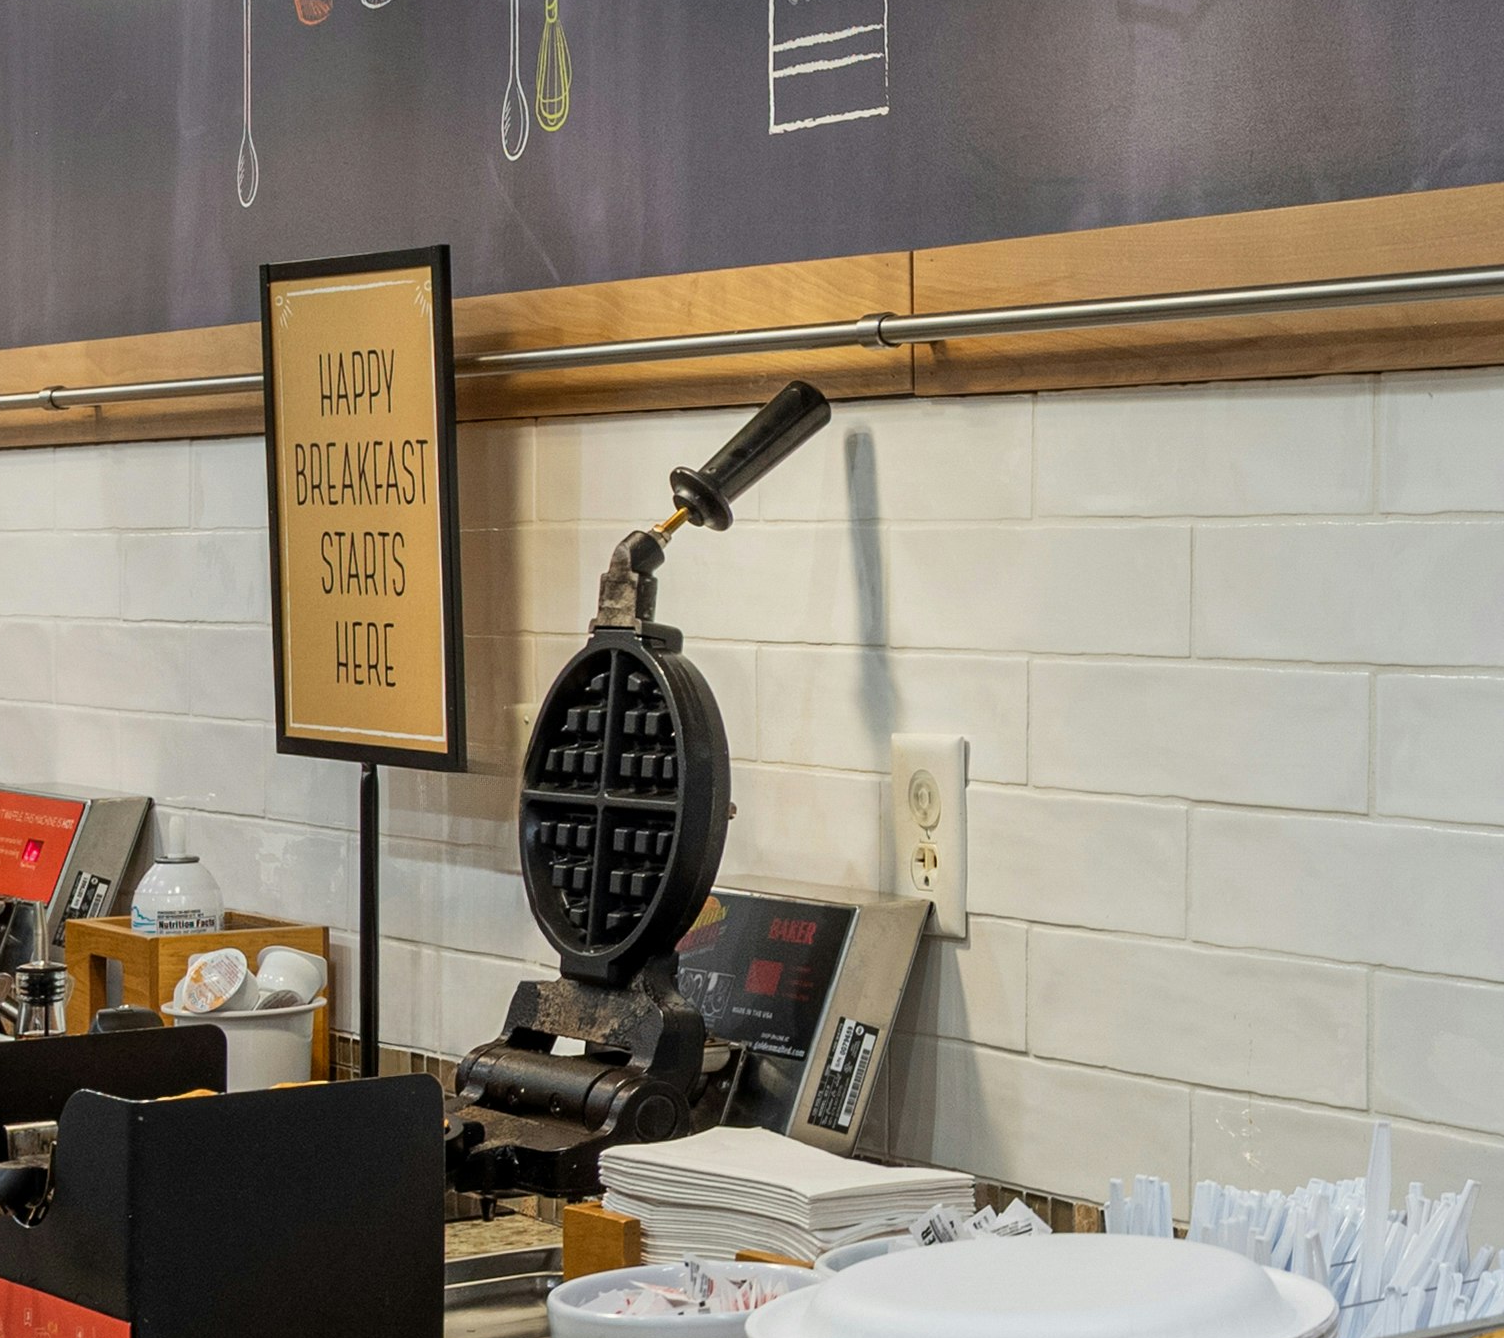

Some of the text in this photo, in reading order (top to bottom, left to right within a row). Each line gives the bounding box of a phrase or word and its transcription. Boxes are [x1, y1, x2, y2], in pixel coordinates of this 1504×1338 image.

[318, 348, 395, 417] HAPPY
[295, 438, 429, 507] BREAKFAST
[321, 530, 406, 597] STARTS
[335, 620, 397, 688] HERE
[158, 918, 215, 930] Nutrition Facts
[768, 917, 818, 945] BAKER
